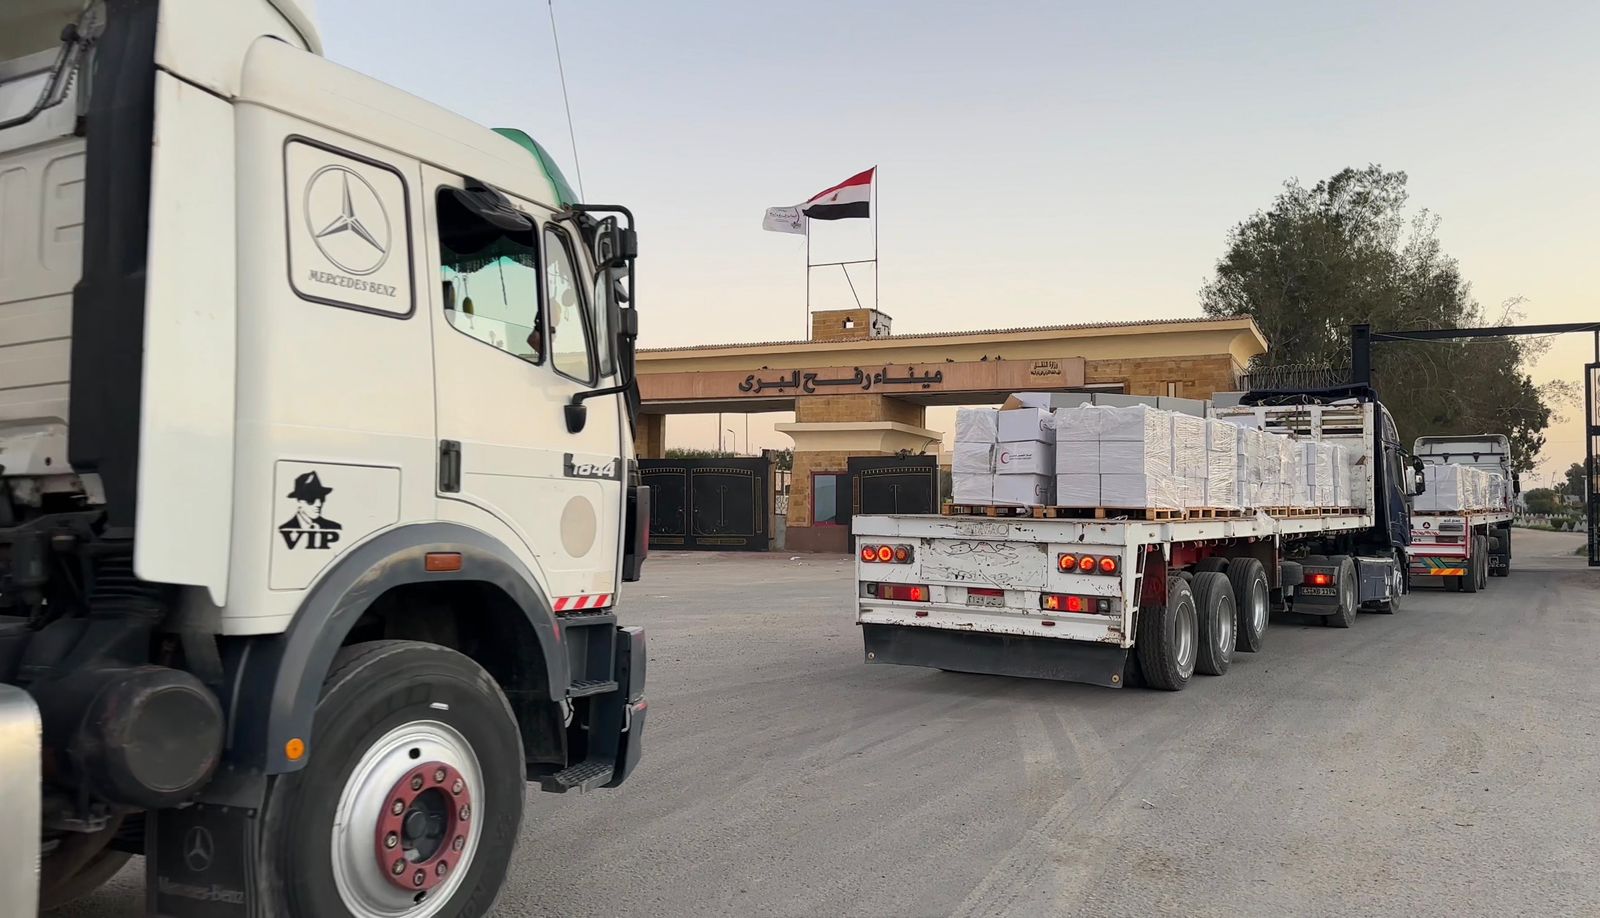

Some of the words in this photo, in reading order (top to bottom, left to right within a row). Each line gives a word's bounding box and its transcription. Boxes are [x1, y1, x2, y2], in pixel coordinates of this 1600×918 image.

[308, 269, 368, 291] MERCEDES
[369, 281, 397, 298] BENZ
[803, 366, 872, 394] رفح
[873, 366, 943, 389] ميناء
[572, 461, 617, 478] 1844
[279, 530, 340, 550] VIP
